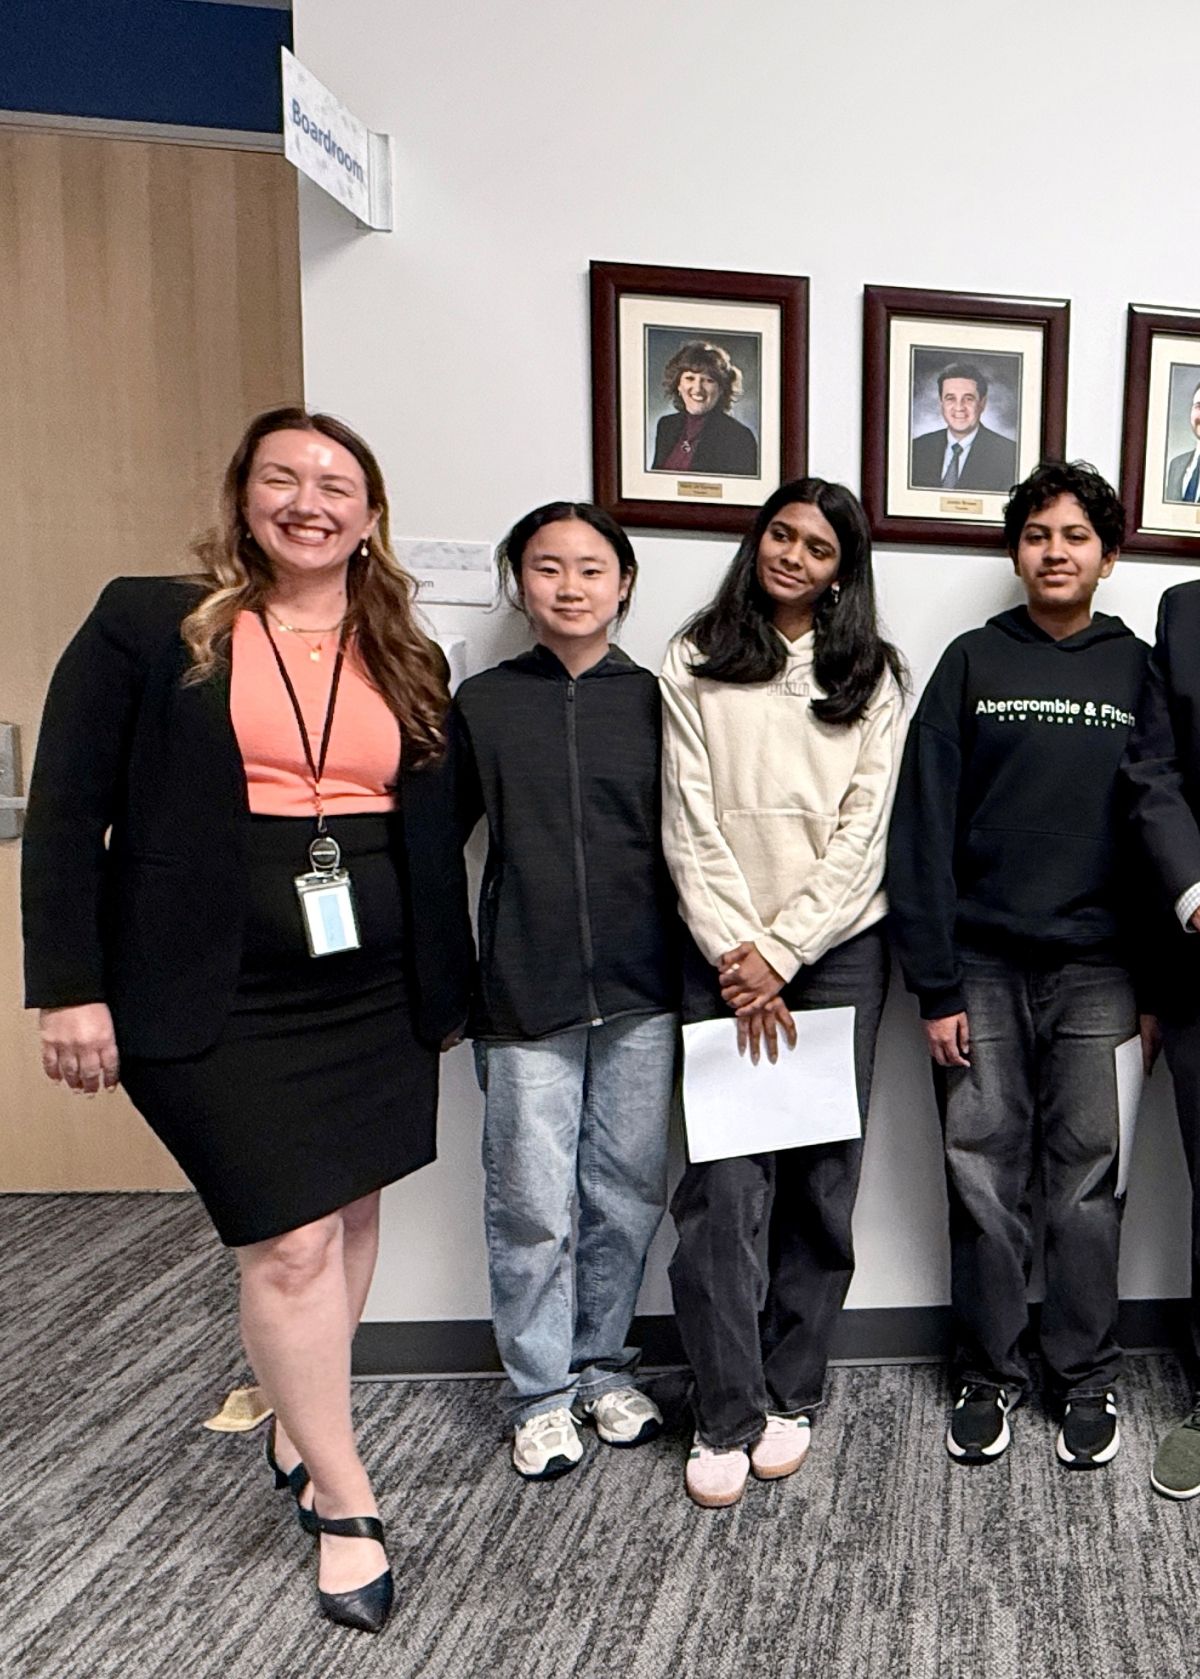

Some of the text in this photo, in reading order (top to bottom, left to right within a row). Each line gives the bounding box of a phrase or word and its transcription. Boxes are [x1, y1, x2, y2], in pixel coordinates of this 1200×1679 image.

[292, 98, 364, 183] Boardroom
[975, 699, 1136, 727] Abercrombie & Fitch
